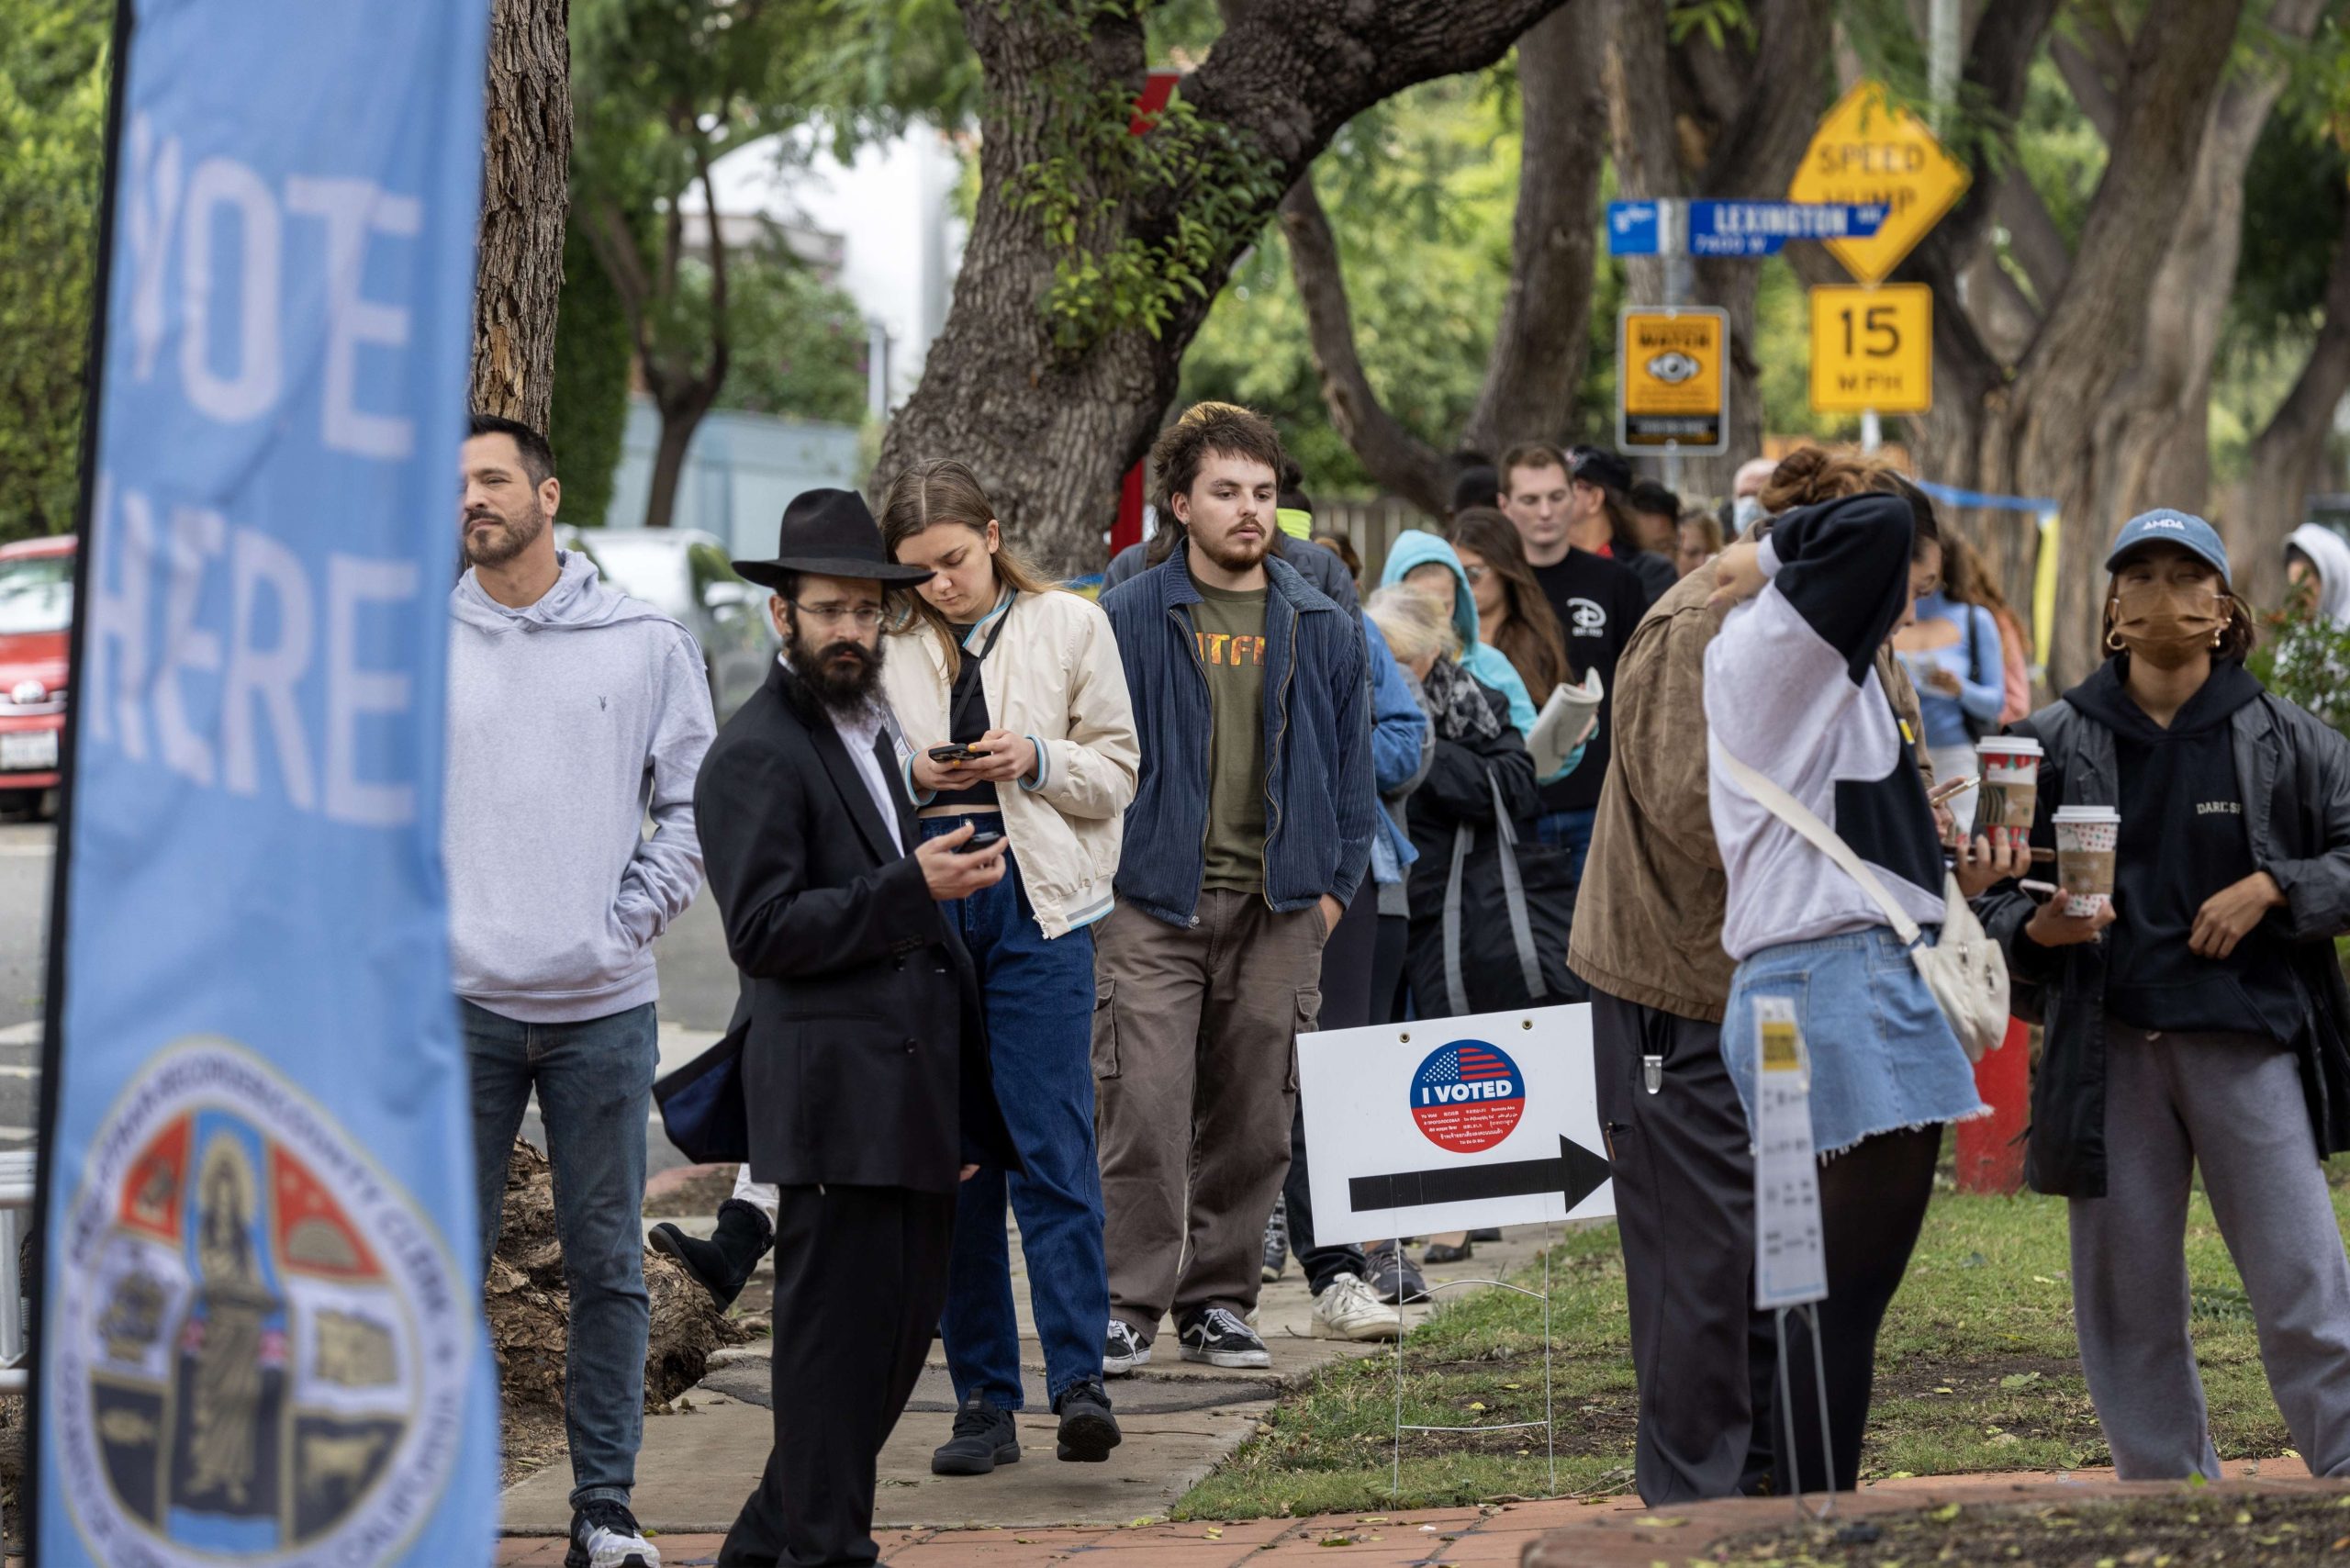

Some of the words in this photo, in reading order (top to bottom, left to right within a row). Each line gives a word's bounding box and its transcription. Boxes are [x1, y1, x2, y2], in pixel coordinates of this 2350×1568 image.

[1818, 143, 1926, 175] SPEED
[1713, 204, 1849, 235] LEXINGTON
[130, 112, 421, 462] VOTE
[1841, 307, 1901, 358] 15
[2143, 518, 2186, 531] AMDA
[88, 471, 421, 828] HERE
[1422, 1087, 1430, 1104] I
[1434, 1080, 1513, 1103] VOTED
